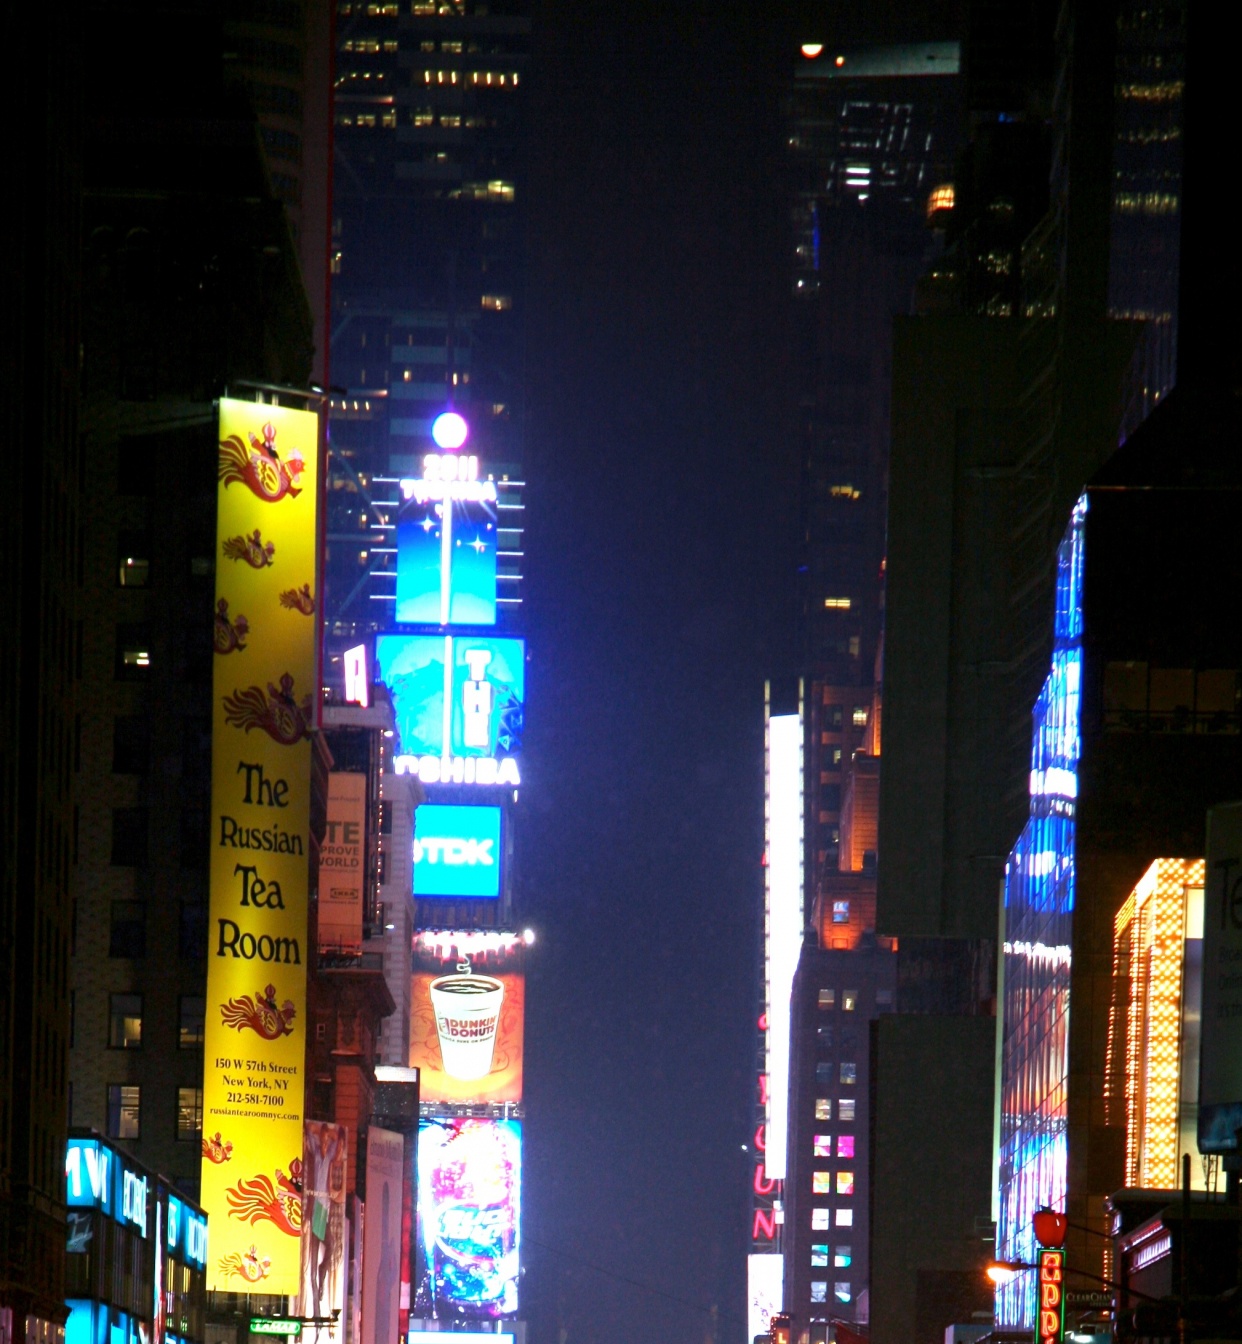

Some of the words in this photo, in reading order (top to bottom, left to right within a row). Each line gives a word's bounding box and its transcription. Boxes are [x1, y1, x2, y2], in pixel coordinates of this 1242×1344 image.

[236, 761, 289, 808] The
[219, 815, 304, 856] Russian
[327, 821, 360, 844] TE
[319, 845, 360, 856] PROVE
[419, 838, 495, 866] TDK
[233, 862, 286, 910] Tea
[216, 918, 302, 965] Room
[450, 1023, 495, 1038] DONUTS
[215, 1058, 231, 1069] 150
[233, 1059, 244, 1070] W
[246, 1060, 267, 1072] 57th
[269, 1062, 297, 1074] Street
[222, 1075, 245, 1086] New
[247, 1077, 272, 1090] York,
[274, 1079, 290, 1090] NY
[227, 1092, 284, 1107] 212-581-7100
[210, 1107, 300, 1121] russiantearoomnyc.com
